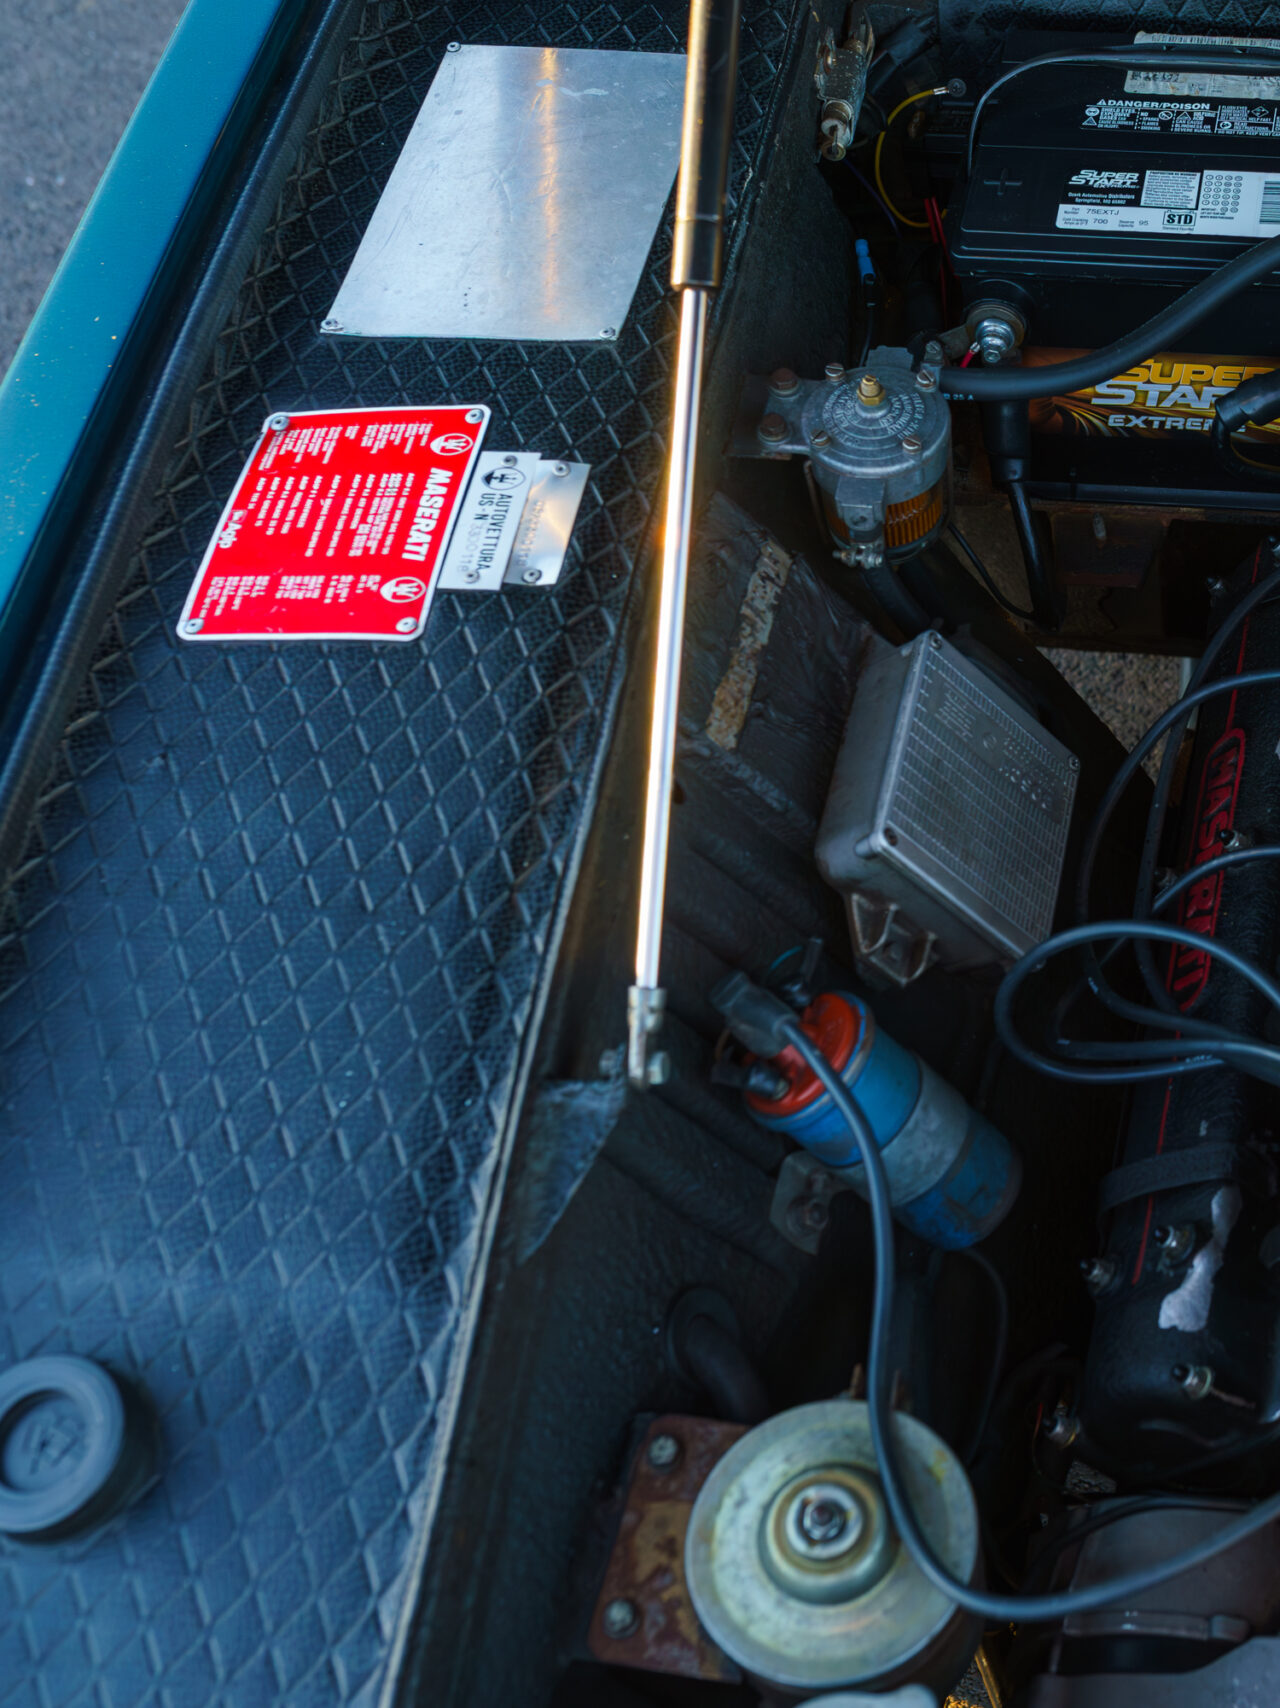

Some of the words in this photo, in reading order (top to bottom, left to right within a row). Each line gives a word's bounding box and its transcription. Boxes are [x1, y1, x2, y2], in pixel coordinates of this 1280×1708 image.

[1107, 99, 1210, 110] DANGER/POISON
[1068, 175, 1139, 186] START
[1078, 169, 1139, 180] SUPER
[1086, 208, 1120, 216] 75EXTJ
[1166, 213, 1193, 225] STD
[1091, 381, 1236, 409] STA
[401, 467, 454, 561] MASERATI
[218, 521, 243, 549] Agip
[476, 494, 512, 571] AUTOVETTURA
